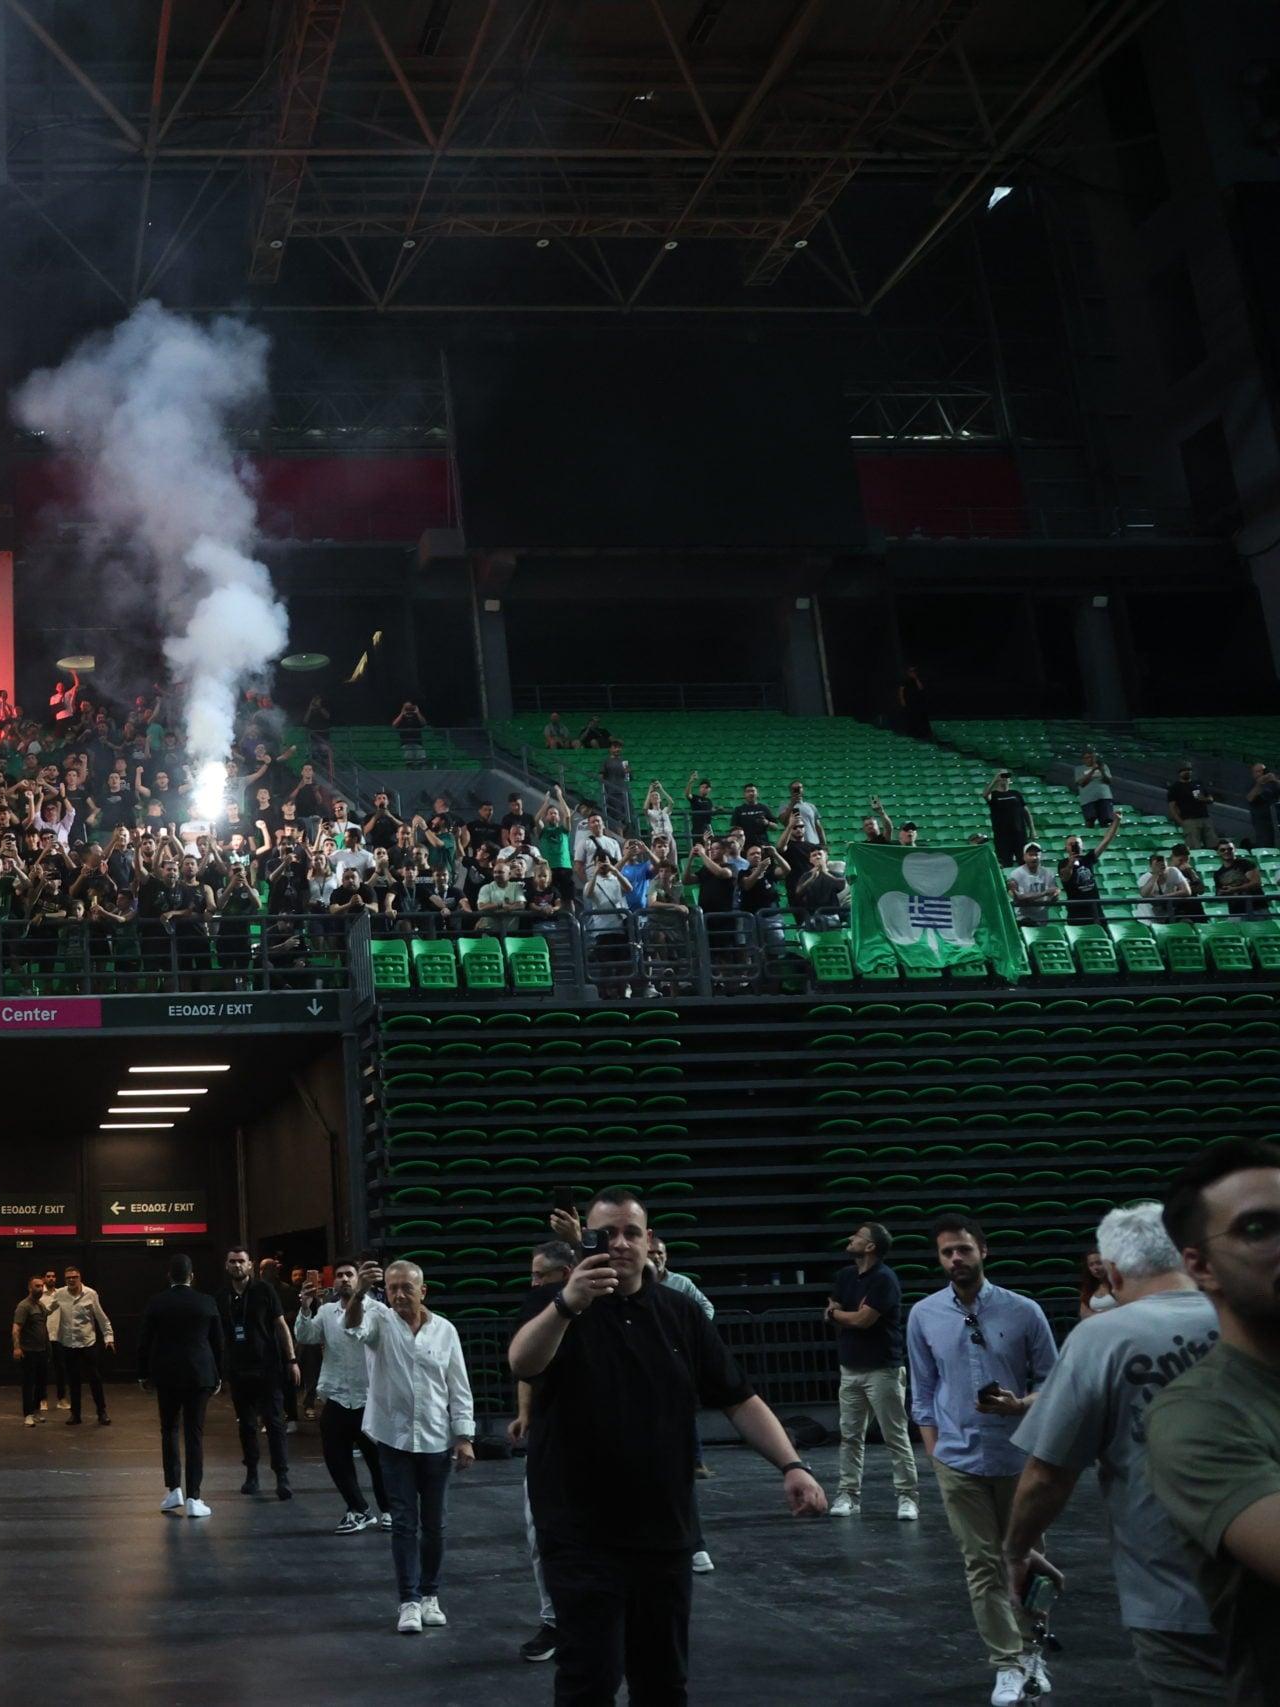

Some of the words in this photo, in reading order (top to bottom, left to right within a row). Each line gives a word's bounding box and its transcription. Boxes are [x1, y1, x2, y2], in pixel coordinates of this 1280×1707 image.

[1, 1007, 58, 1021] Center
[168, 1004, 216, 1016] ΕΞΟΔΟΣ
[218, 1003, 224, 1016] /
[226, 1003, 254, 1015] EXIT
[1, 1205, 37, 1215] ΕΞΟΔΟΣ
[44, 1204, 65, 1215] EXIT
[130, 1203, 166, 1213] ΕΞΟΔΟΣ
[174, 1202, 195, 1213] EXIT
